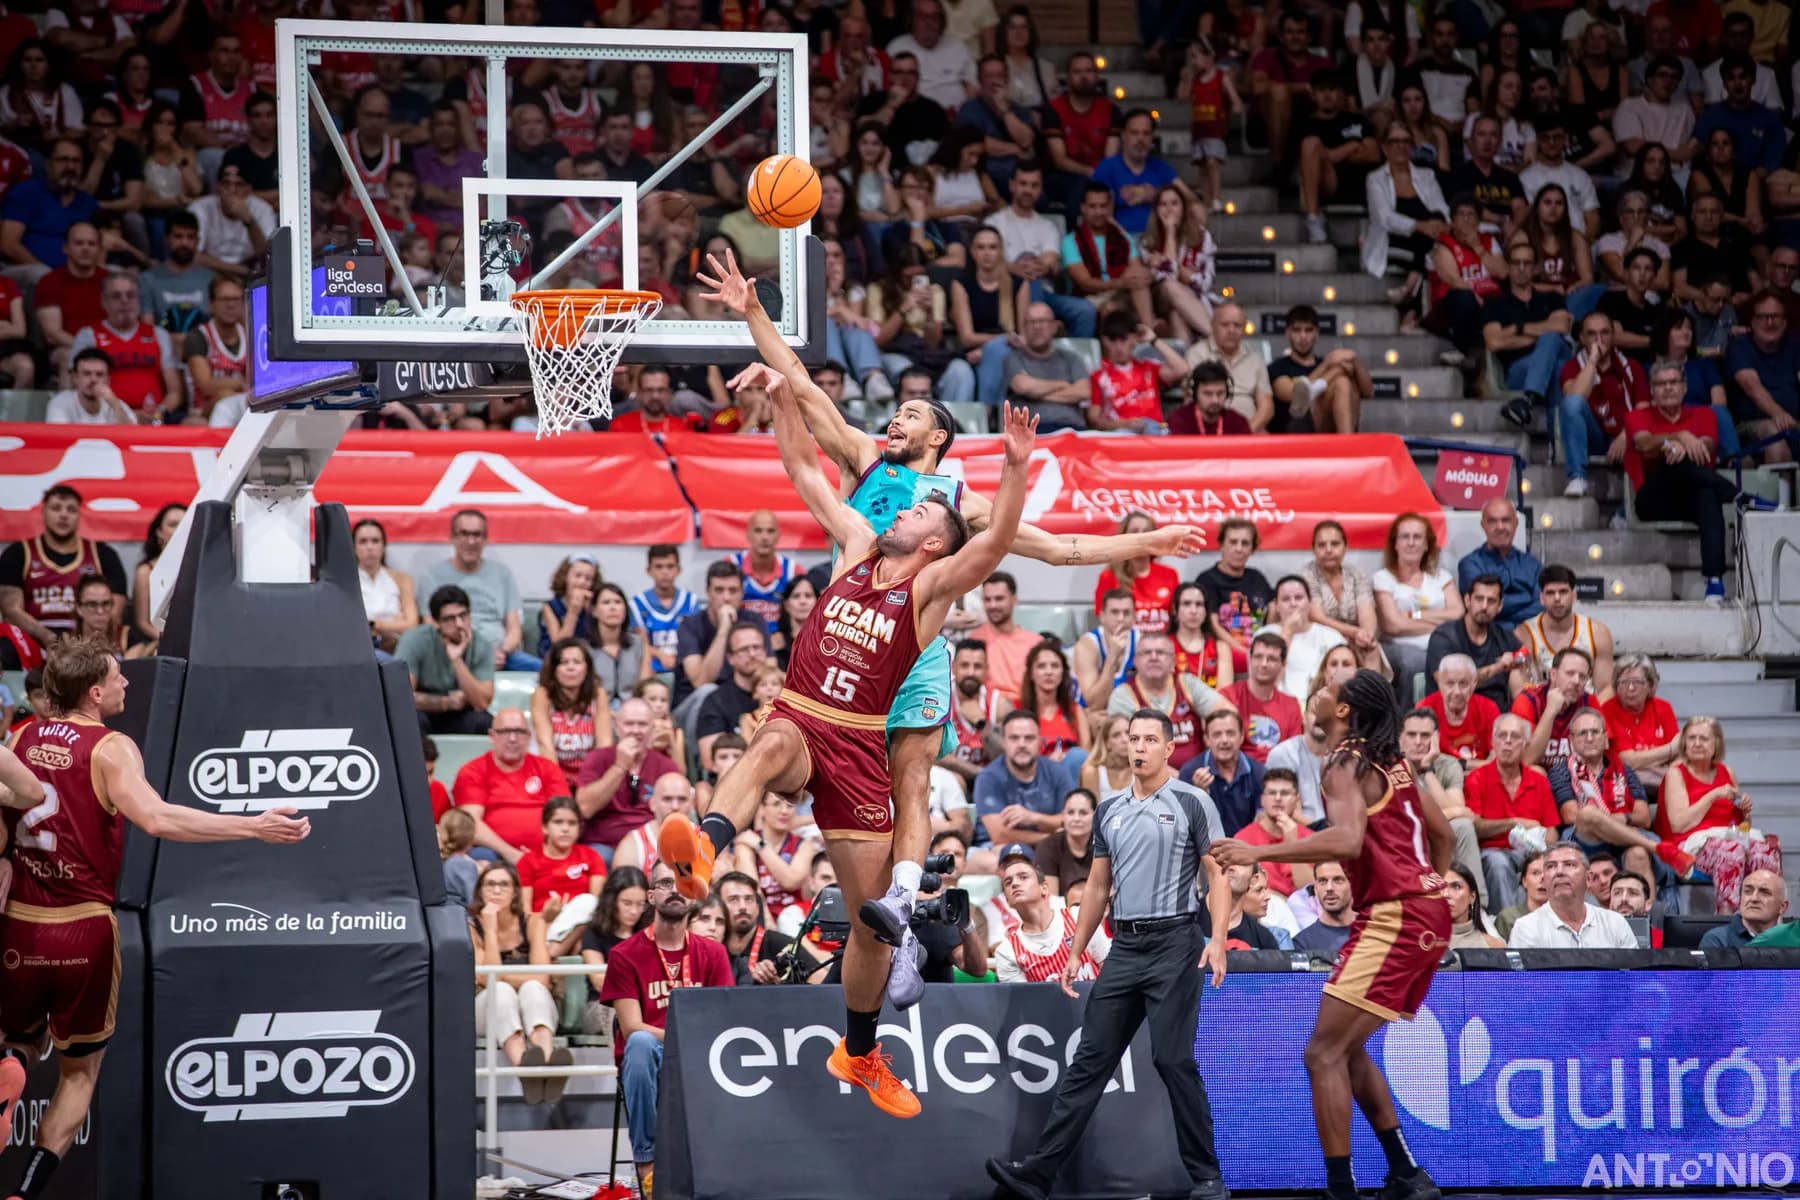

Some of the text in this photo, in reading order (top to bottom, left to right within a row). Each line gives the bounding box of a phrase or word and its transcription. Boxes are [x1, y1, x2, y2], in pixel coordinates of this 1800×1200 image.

[327, 268, 353, 282] liga
[328, 281, 383, 293] endesa
[1445, 468, 1499, 487] MÓDULO
[1072, 488, 1277, 511] AGENCIA DE
[33, 585, 76, 604] UCA
[823, 595, 897, 645] UCAM
[824, 619, 878, 654] MURCIA
[820, 665, 861, 702] 15
[169, 911, 407, 934] Uno más de la familia
